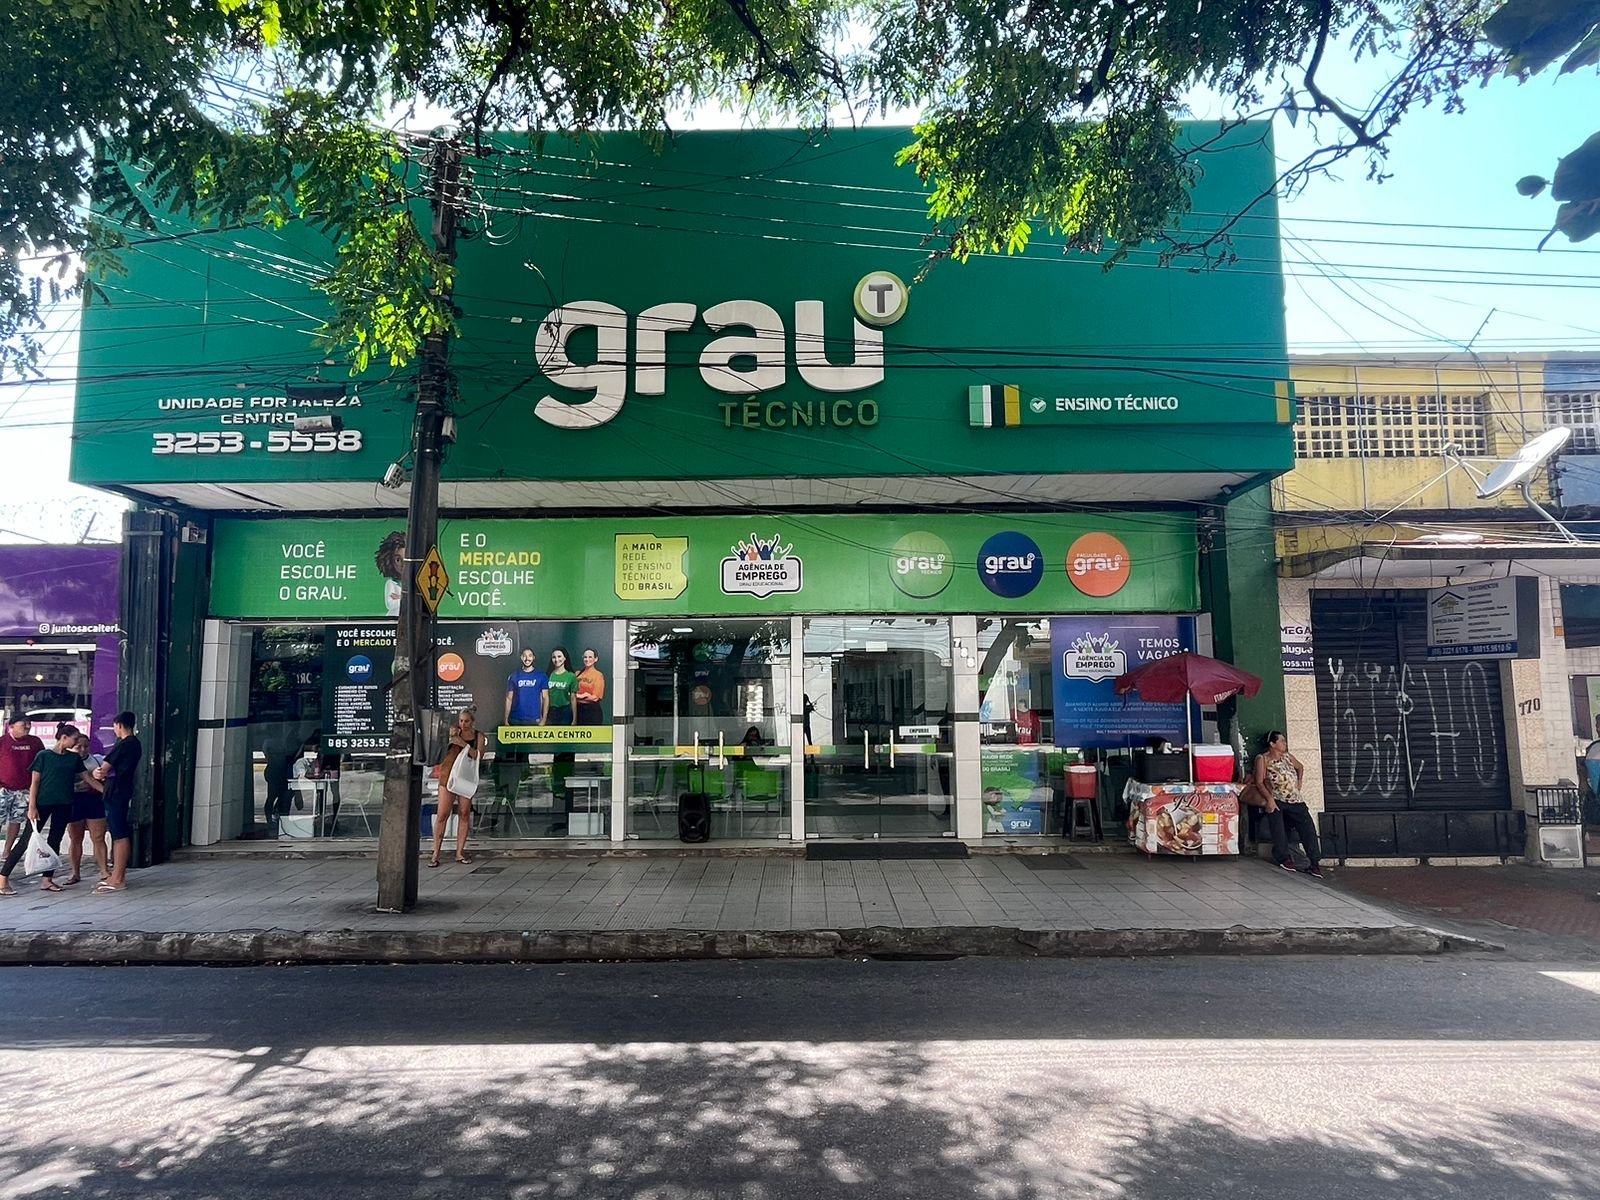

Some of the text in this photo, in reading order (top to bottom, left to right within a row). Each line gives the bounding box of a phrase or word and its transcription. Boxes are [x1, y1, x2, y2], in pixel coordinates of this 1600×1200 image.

[534, 300, 884, 430] grau
[158, 398, 244, 410] UNIDADE
[1055, 394, 1178, 411] ENSINO TÉCNICO
[220, 412, 298, 424] CENTRO
[718, 396, 880, 428] TÉCNICO
[151, 432, 245, 454] 3253
[267, 430, 363, 452] 5558
[460, 534, 486, 546] E O
[281, 541, 325, 558] VOCÊ
[459, 552, 541, 566] MERCADO
[896, 557, 943, 575] grau
[984, 556, 1033, 574] grau
[1073, 557, 1121, 575] grau
[280, 565, 357, 579] ESCOLHE
[458, 571, 534, 585] ESCOLHE
[622, 571, 662, 580] TÉCNICO
[735, 572, 788, 581] EMPREGO
[279, 586, 347, 600] O GRAU.
[638, 582, 673, 590] BRASIL
[458, 589, 506, 606] VOCÊ.
[337, 629, 359, 638] VOCÊ
[1138, 638, 1180, 647] TEMOS
[348, 664, 371, 674] grau
[517, 679, 537, 687] grau
[1518, 698, 1541, 715] 770
[504, 731, 592, 739] FORTALEZA CENTRO
[335, 739, 348, 748] 85
[1010, 820, 1032, 829] grau
